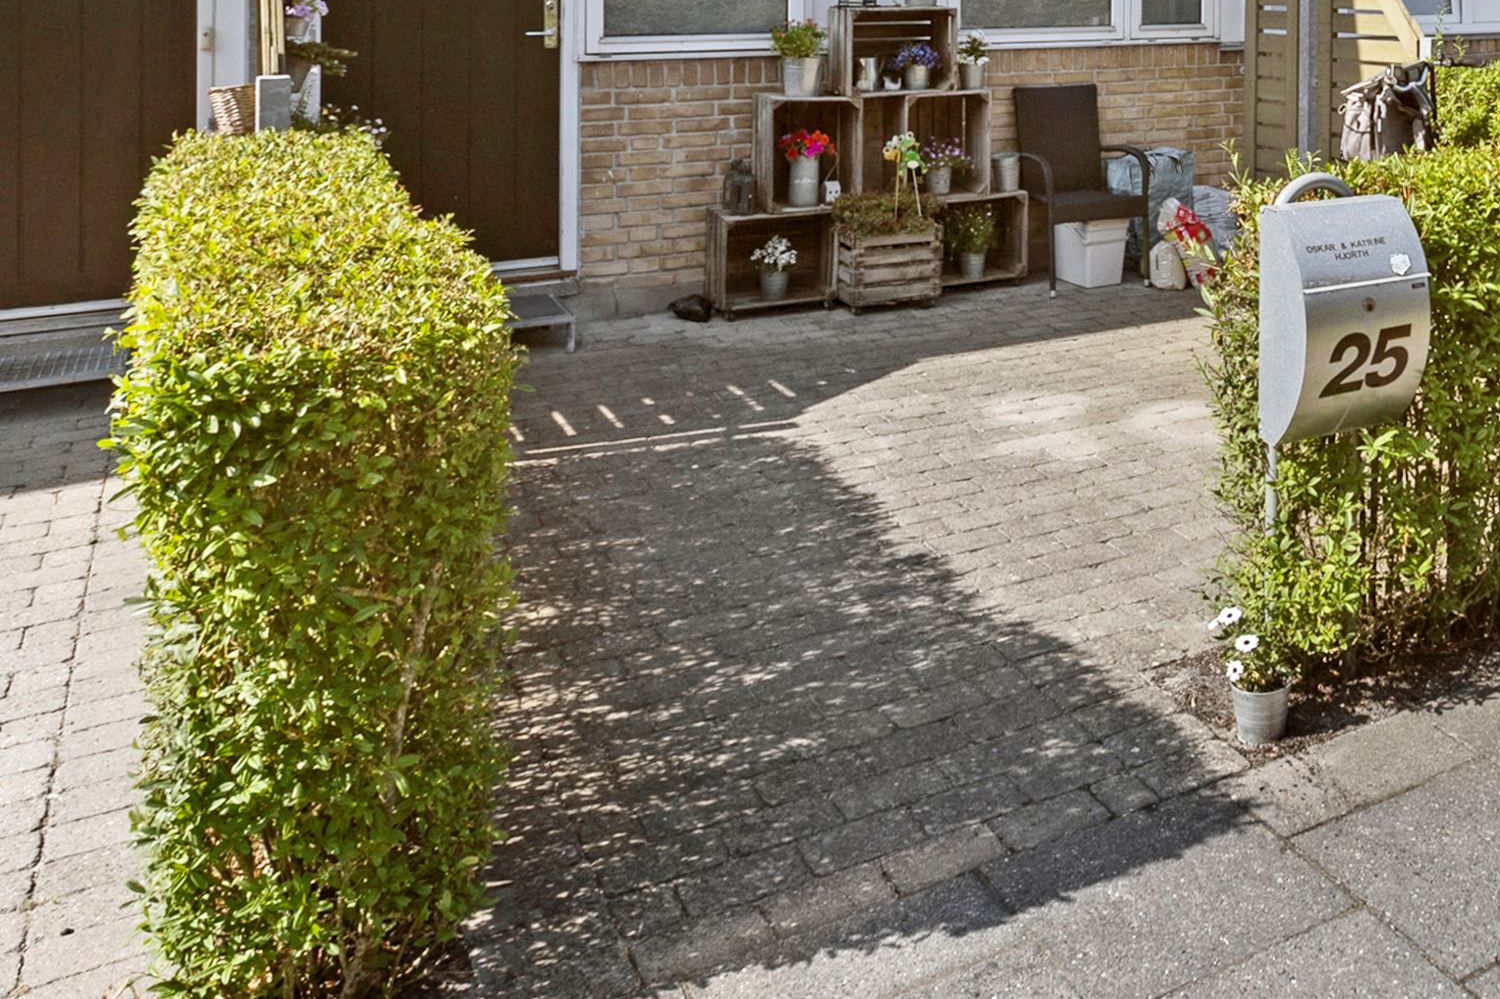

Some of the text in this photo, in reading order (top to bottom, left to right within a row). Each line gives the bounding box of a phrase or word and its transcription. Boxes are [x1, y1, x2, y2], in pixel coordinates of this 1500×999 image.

[1306, 236, 1386, 254] OSKAR & KATRINE
[1334, 250, 1370, 261] HJORTH
[1318, 323, 1412, 399] 25
